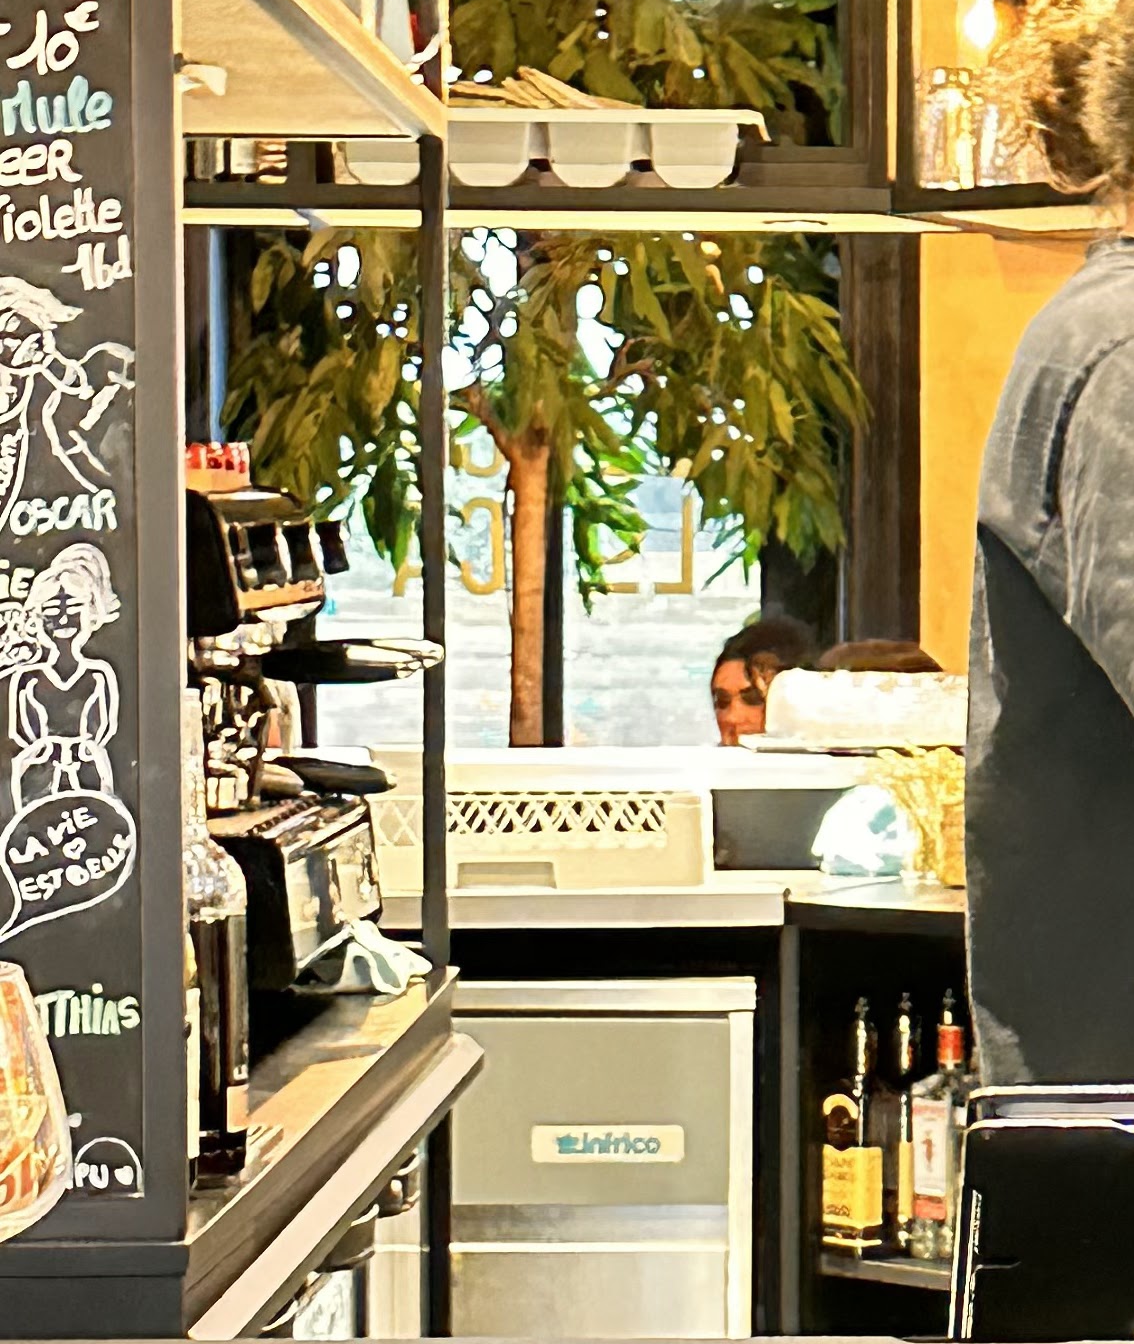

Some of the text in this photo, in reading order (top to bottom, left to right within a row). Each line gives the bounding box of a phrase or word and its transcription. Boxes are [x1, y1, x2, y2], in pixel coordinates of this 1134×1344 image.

[9, 488, 118, 536] OSCAR
[8, 836, 50, 864] LA
[18, 867, 64, 902] EST
